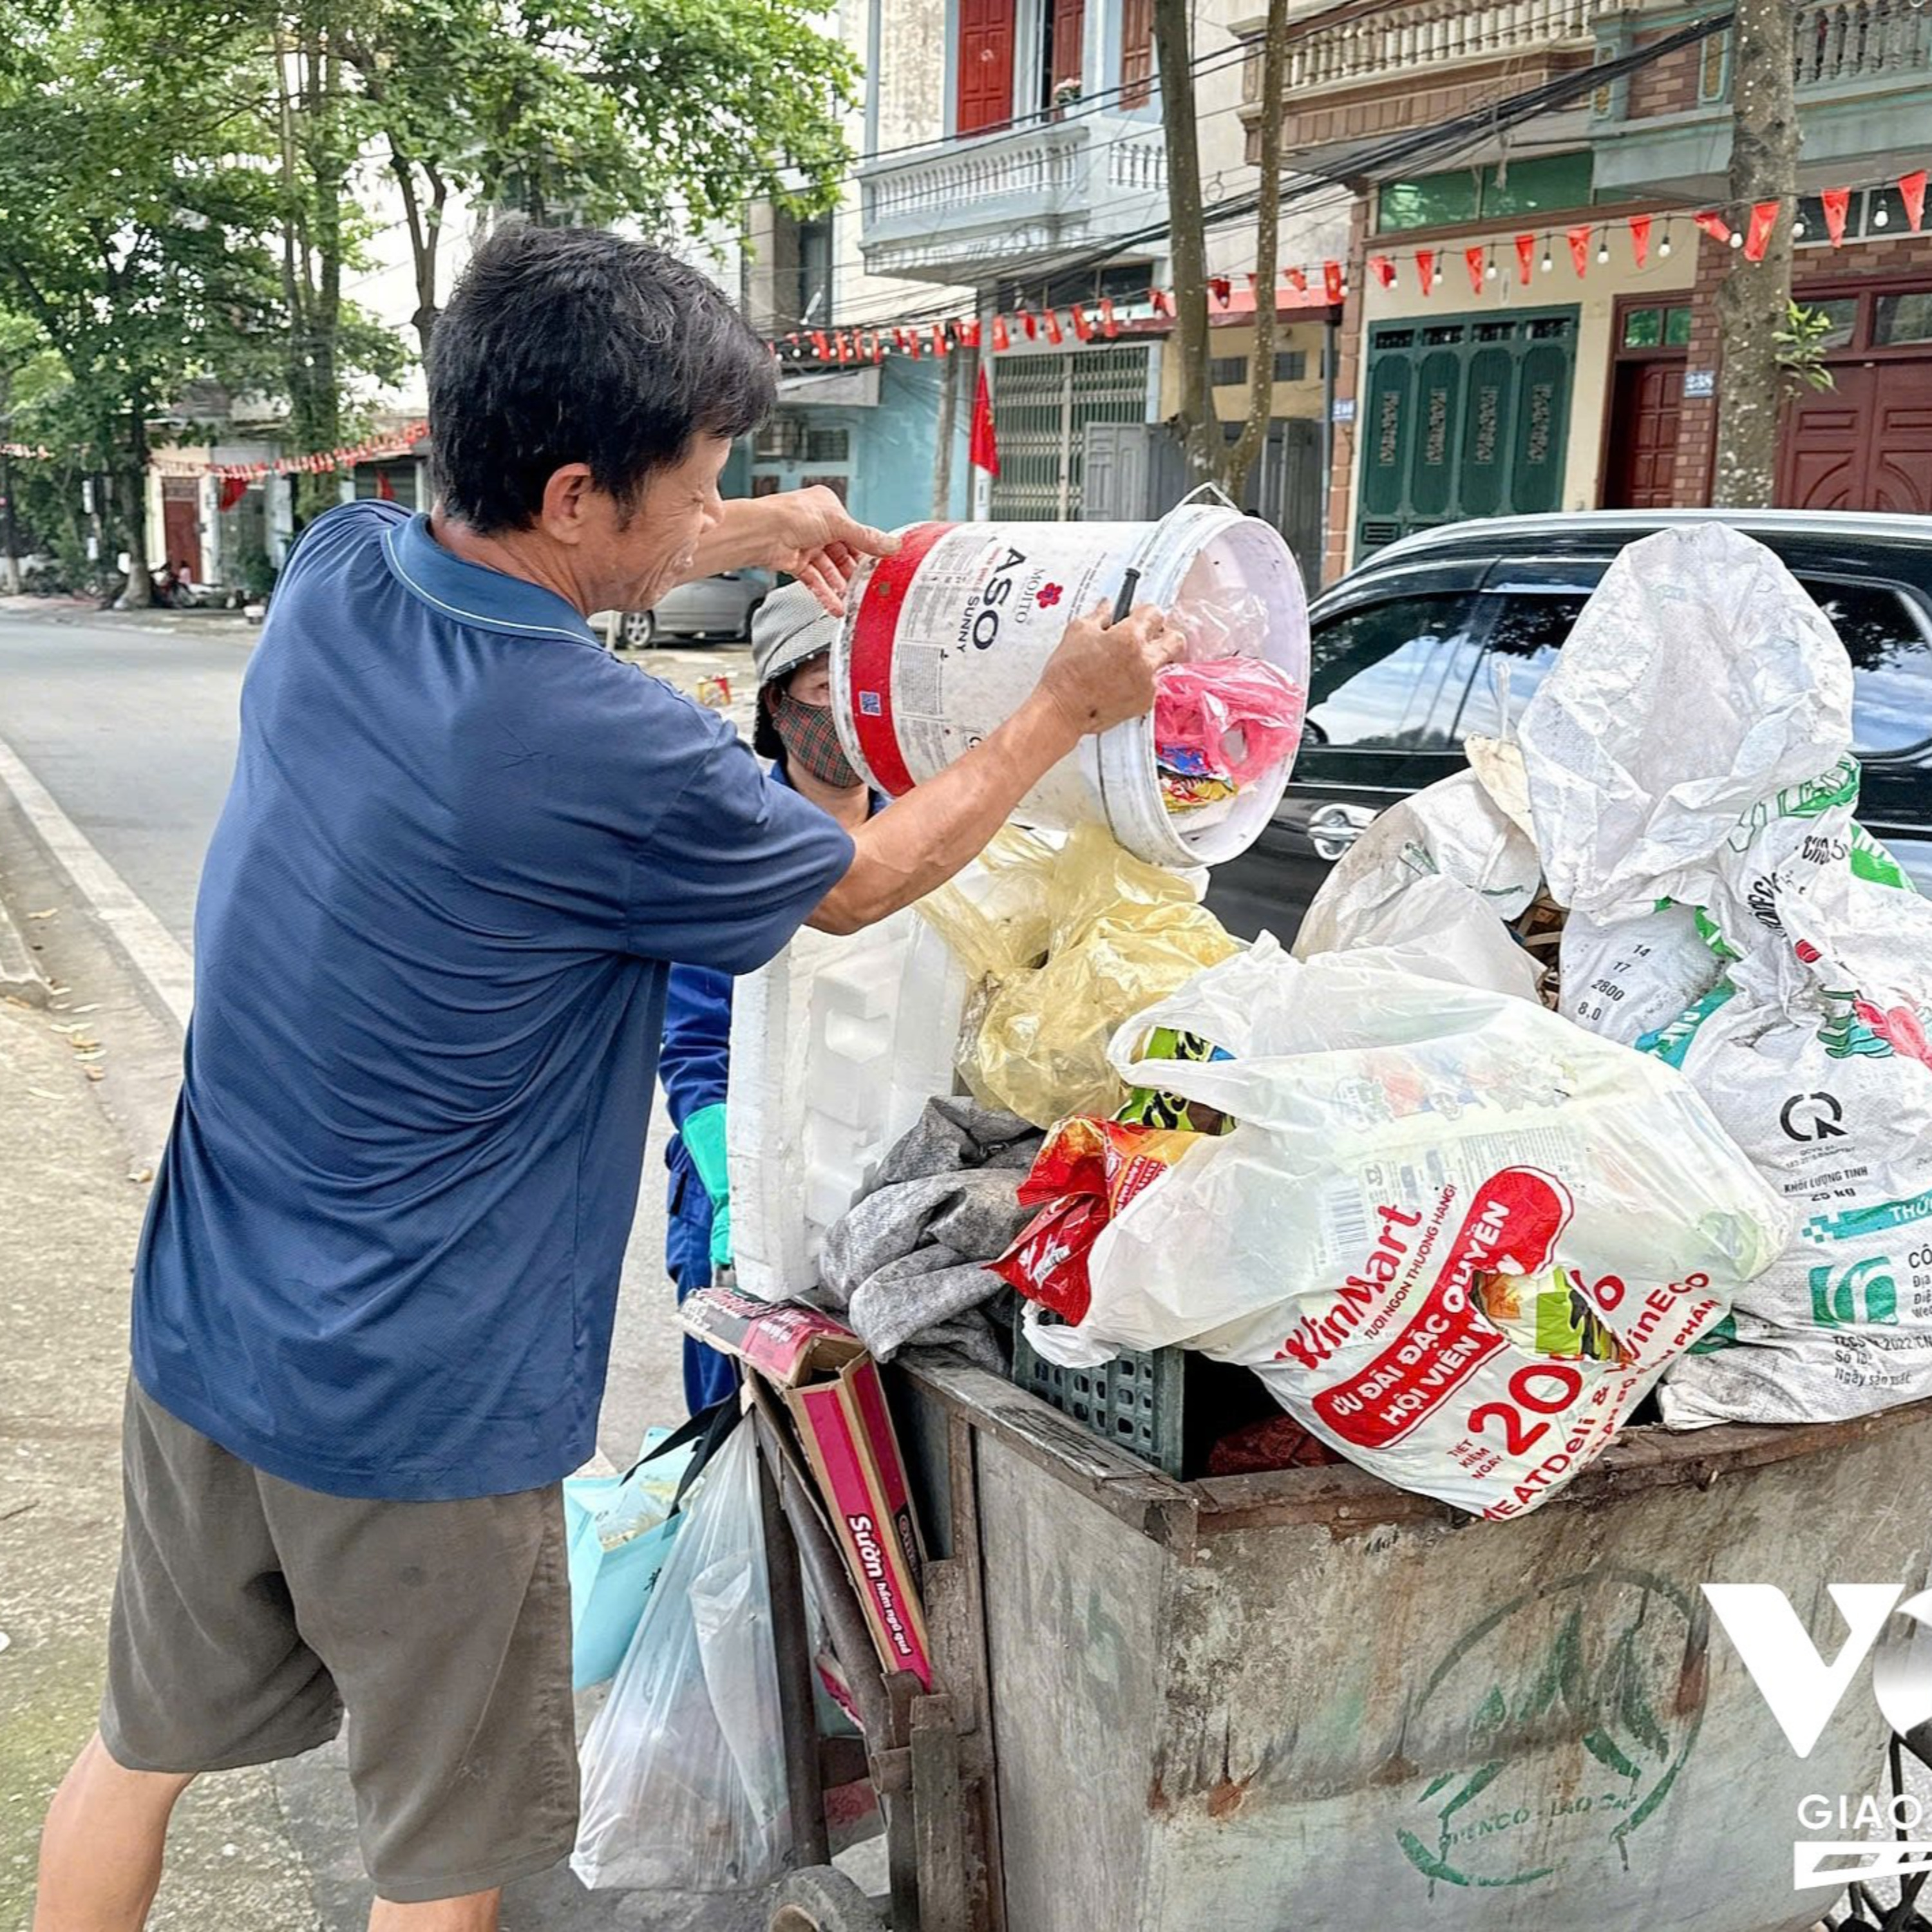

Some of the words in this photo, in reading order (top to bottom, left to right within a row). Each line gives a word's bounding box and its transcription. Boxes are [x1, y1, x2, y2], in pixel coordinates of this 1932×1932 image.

[972, 548, 1027, 650] ASO
[1015, 569, 1045, 623] MOJITO
[956, 596, 980, 652] SUNNY
[1613, 961, 1631, 973] 17
[1633, 945, 1651, 958] 14
[1591, 979, 1625, 1001] 2800
[1889, 1195, 1932, 1222] THỨ
[1275, 1204, 1422, 1370] WinMart
[1383, 1281, 1412, 1318] NGON
[1358, 1365, 1405, 1399] ĐÃI
[1397, 1314, 1449, 1365] ĐẶC
[1380, 1388, 1430, 1425] HỘI
[1420, 1336, 1481, 1387] VIÊN
[1592, 1386, 1609, 1405] &
[1472, 1455, 1504, 1479] NGAY
[848, 1515, 884, 1579] Sườn
